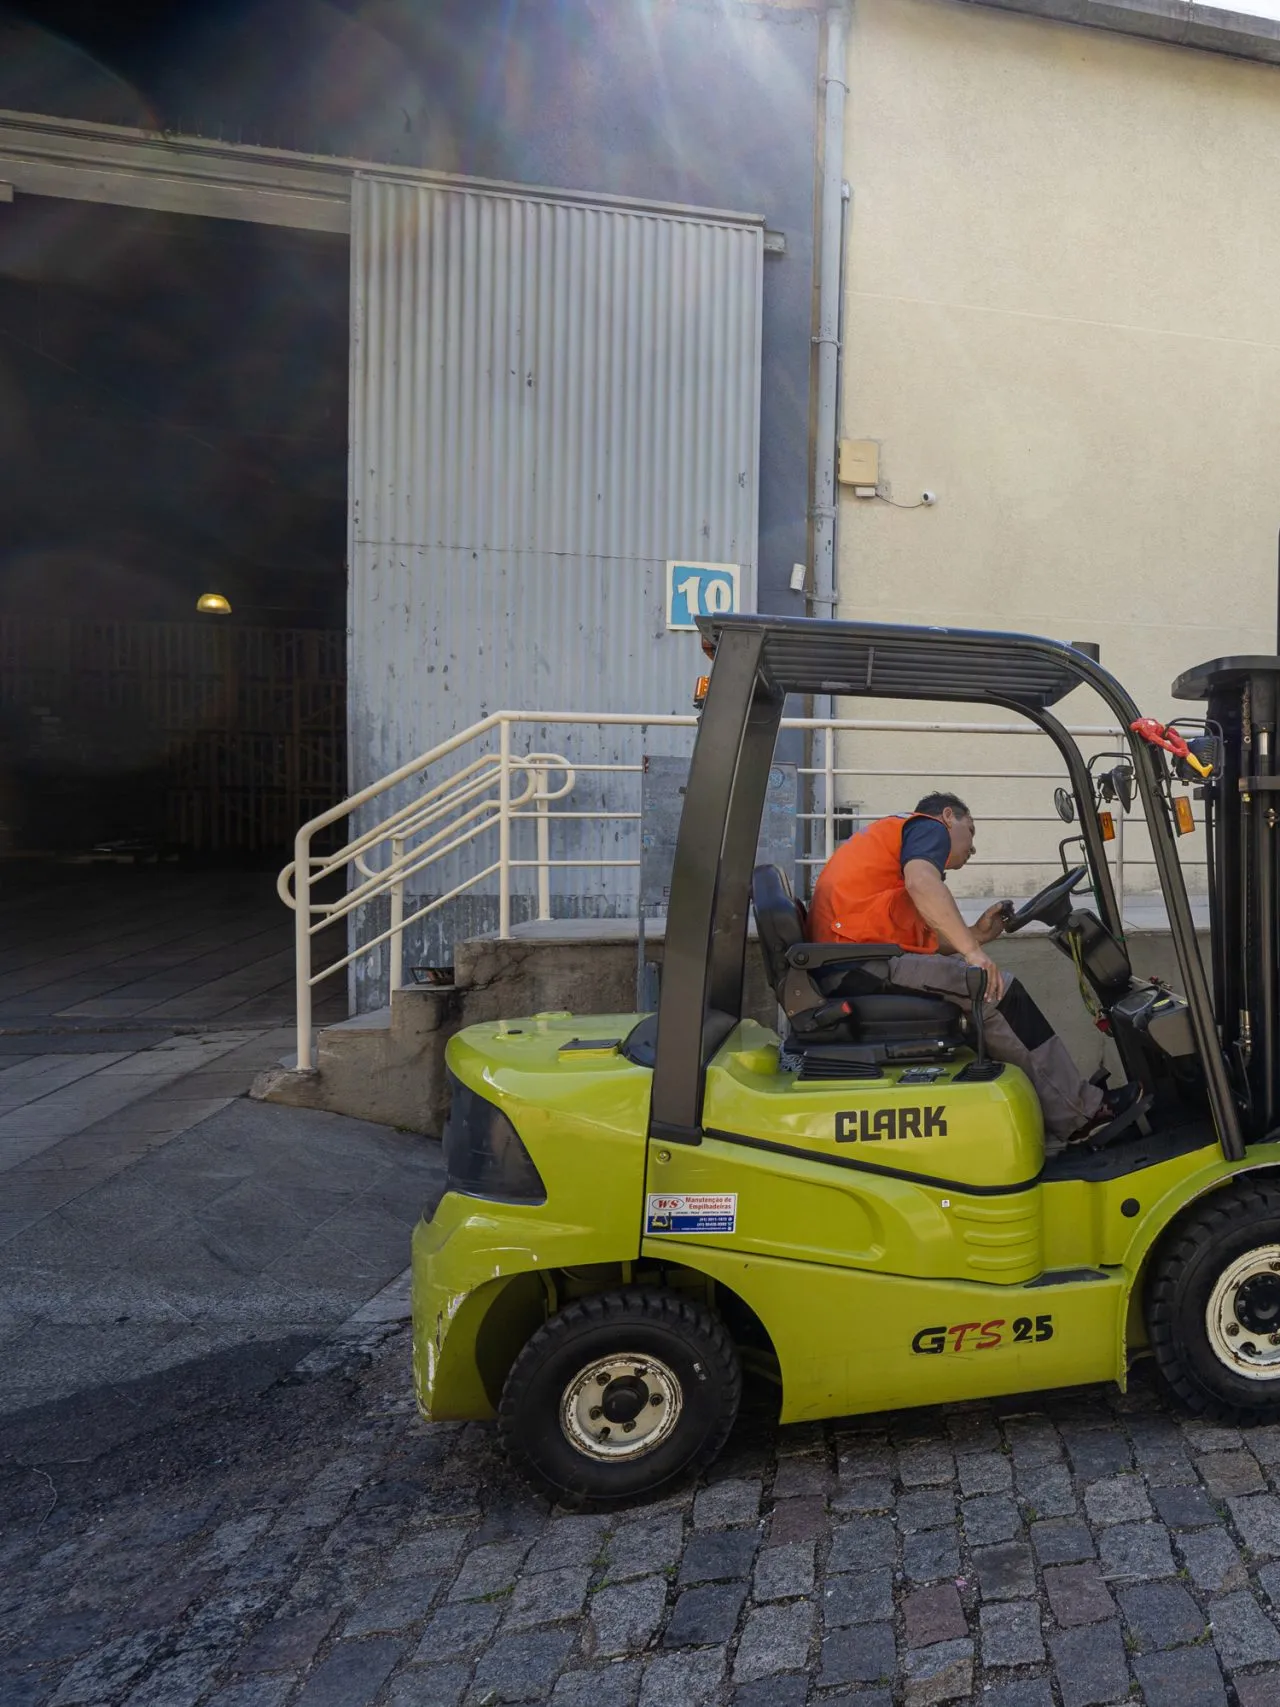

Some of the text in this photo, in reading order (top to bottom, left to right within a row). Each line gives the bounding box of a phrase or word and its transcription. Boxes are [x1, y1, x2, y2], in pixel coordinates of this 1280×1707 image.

[678, 576, 732, 615] 10
[835, 1106, 947, 1143] CLARK
[658, 1199, 679, 1209] WS
[685, 1196, 723, 1204] Manutenção
[912, 1315, 1054, 1354] GTS 25
